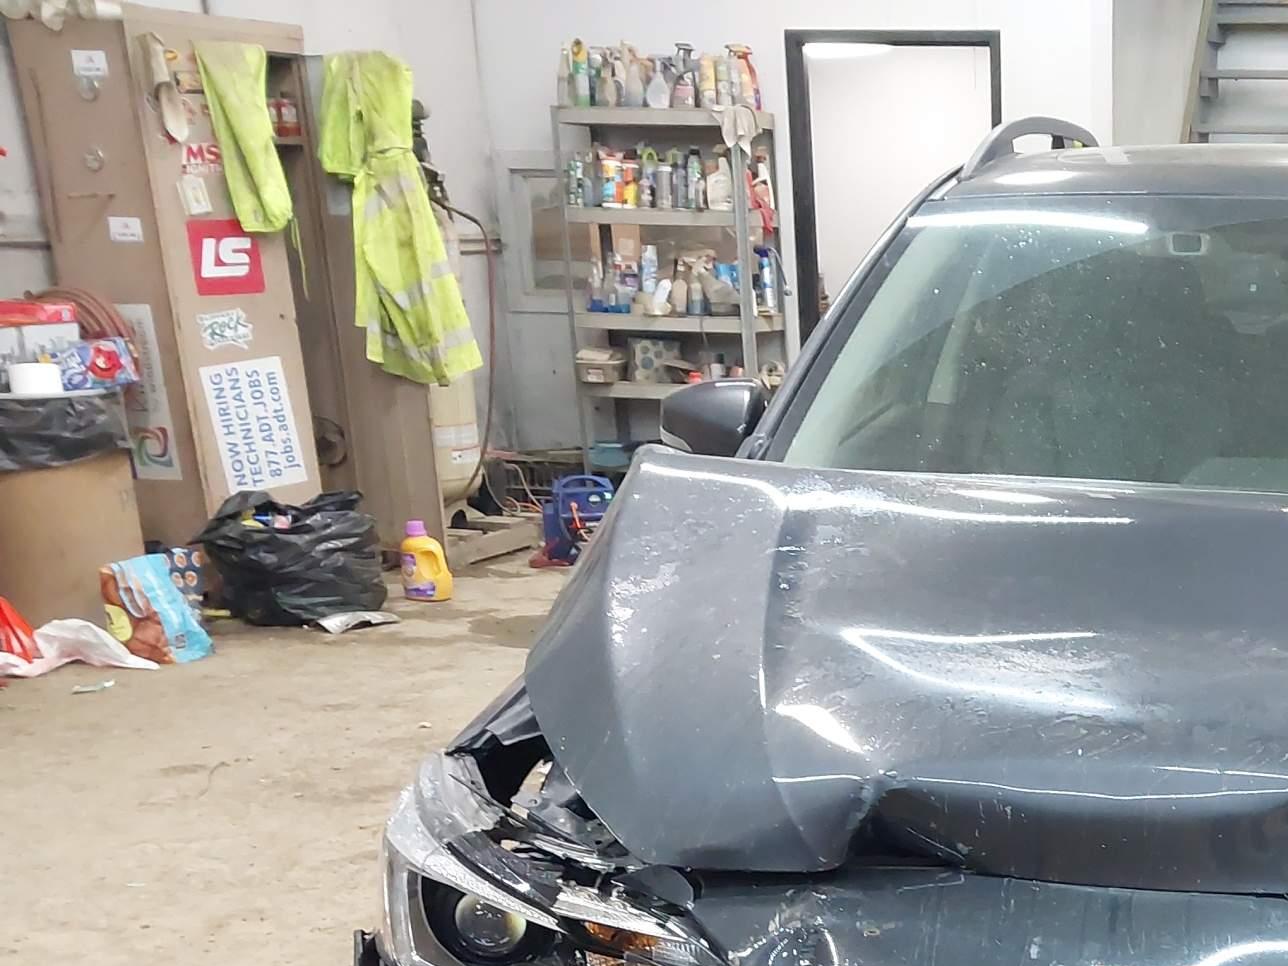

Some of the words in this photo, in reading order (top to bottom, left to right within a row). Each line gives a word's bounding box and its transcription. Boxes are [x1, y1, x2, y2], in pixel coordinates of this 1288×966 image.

[201, 237, 251, 278] LS
[210, 373, 235, 436] HIRING
[225, 367, 264, 487] TECHNICIANS
[266, 372, 302, 469] jobs.adt.com
[226, 442, 248, 486] NOW
